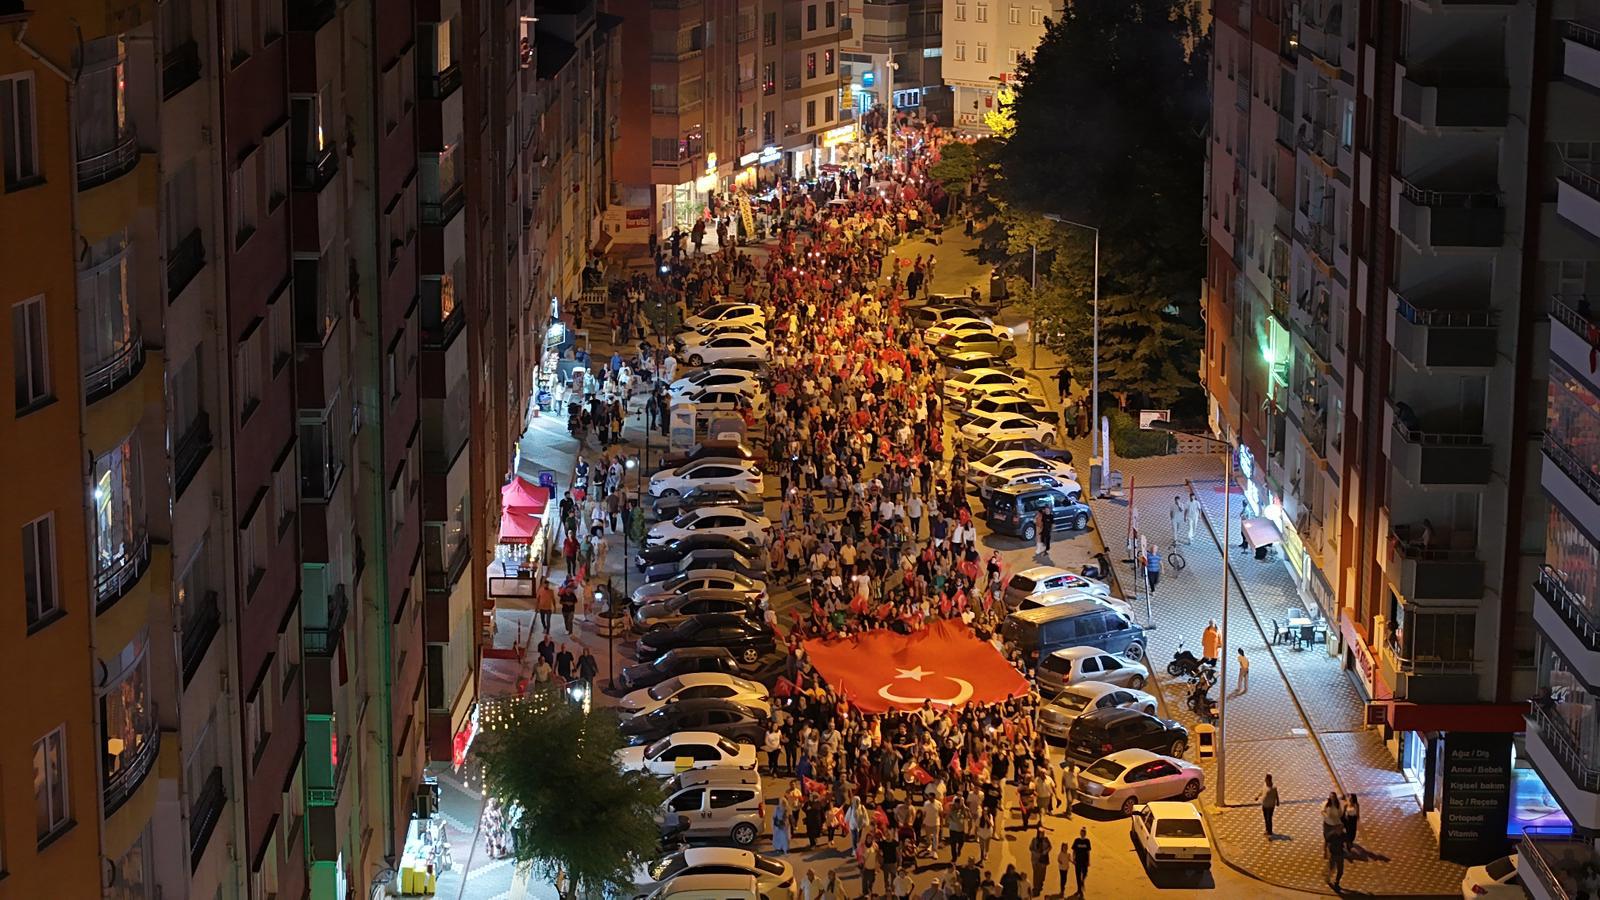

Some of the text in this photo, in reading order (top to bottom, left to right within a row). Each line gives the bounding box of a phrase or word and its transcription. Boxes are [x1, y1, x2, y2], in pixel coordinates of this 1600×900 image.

[1451, 765, 1473, 773] Anne
[1478, 765, 1503, 773] Bebek
[1450, 782, 1478, 790] Kişisel
[1470, 798, 1498, 806] Reçete
[1449, 814, 1484, 823] Ortopedi
[1448, 830, 1479, 838] Vitamin
